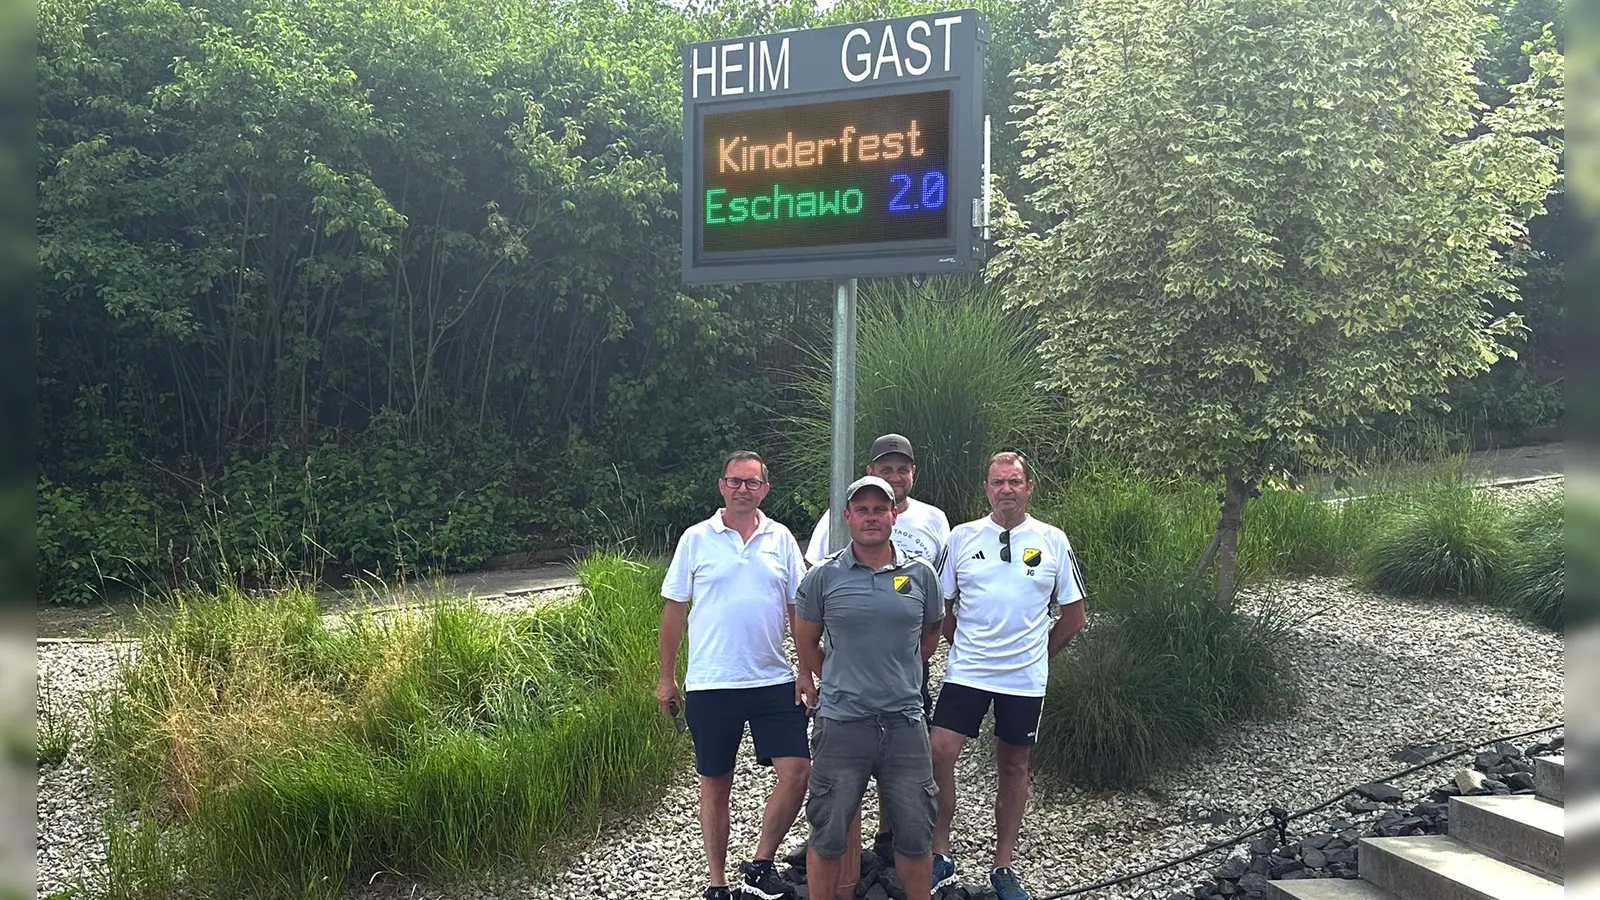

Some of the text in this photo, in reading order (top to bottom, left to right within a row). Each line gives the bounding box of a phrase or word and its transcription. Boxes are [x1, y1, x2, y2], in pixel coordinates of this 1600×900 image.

[692, 16, 962, 98] HEIM GAST
[719, 119, 925, 173] Kinderfest
[706, 171, 945, 225] Eschawo 2.0
[894, 529, 913, 539] TAGE
[1026, 569, 1035, 577] JG
